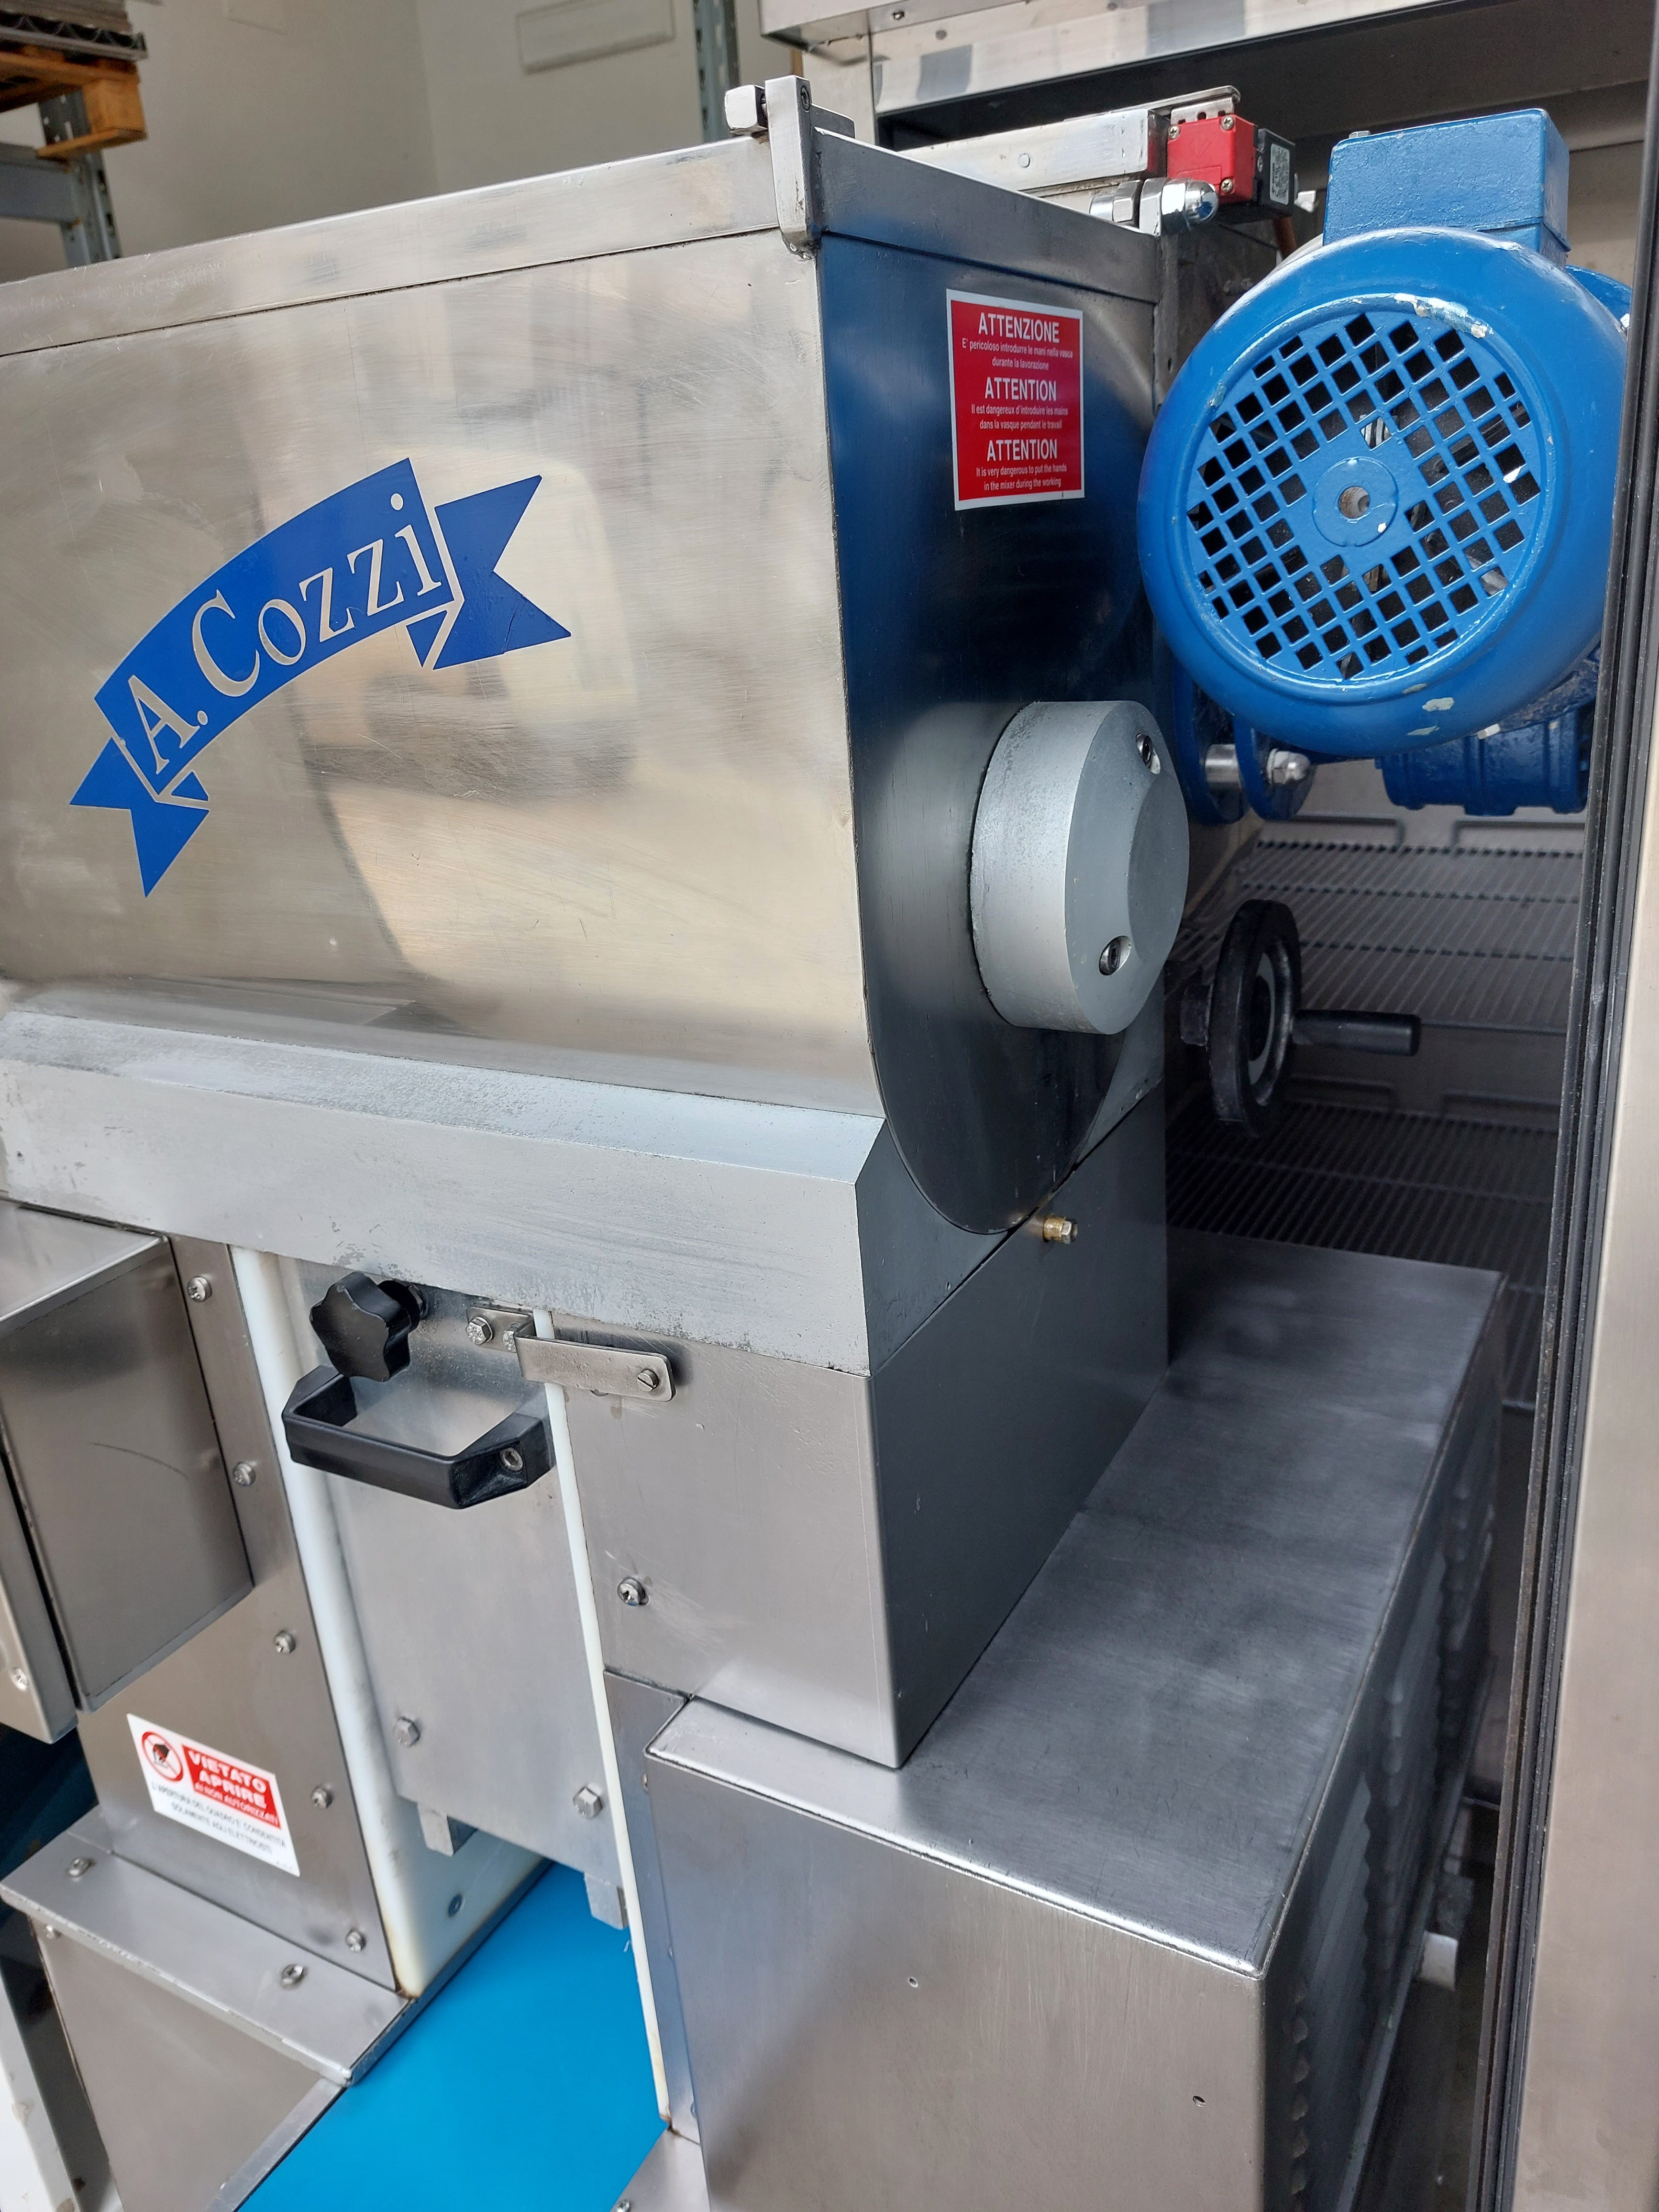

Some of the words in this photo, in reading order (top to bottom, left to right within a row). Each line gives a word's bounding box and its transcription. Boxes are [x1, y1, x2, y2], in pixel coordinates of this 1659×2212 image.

[978, 312, 1060, 343] ATTENZIONE
[962, 338, 968, 348] E'
[970, 340, 999, 352] pericoloso
[1000, 343, 1027, 354] introdurre
[1028, 345, 1033, 354] le
[1034, 347, 1046, 355] mani
[1047, 348, 1059, 357] nella
[992, 356, 1013, 367] durante
[1014, 358, 1019, 367] la
[1020, 359, 1049, 370] lavorazione
[985, 377, 1056, 401] ATTENTION
[972, 404, 975, 414] Il
[976, 406, 984, 414] est
[986, 405, 1014, 416] dangereux
[1016, 405, 1045, 415] d'introduire
[1054, 408, 1068, 416] mains
[980, 420, 993, 429] dans
[995, 419, 999, 429] la
[1000, 421, 1019, 431] vasque
[1020, 420, 1041, 431] pendant
[1042, 420, 1046, 429] le
[1047, 420, 1062, 429] travail
[987, 439, 1057, 462] ATTENTION
[976, 467, 980, 477] It
[982, 468, 986, 476] is
[987, 468, 999, 478] very
[1000, 466, 1028, 477] dangerous
[1035, 465, 1043, 475] put
[1052, 464, 1067, 472] hands
[984, 482, 989, 490] in
[990, 482, 999, 490] the
[1000, 481, 1015, 489] mixer
[1016, 479, 1032, 489] during
[1042, 477, 1061, 487] working
[187, 1749, 267, 1794] VIETATO
[198, 1769, 267, 1810] APRIRE
